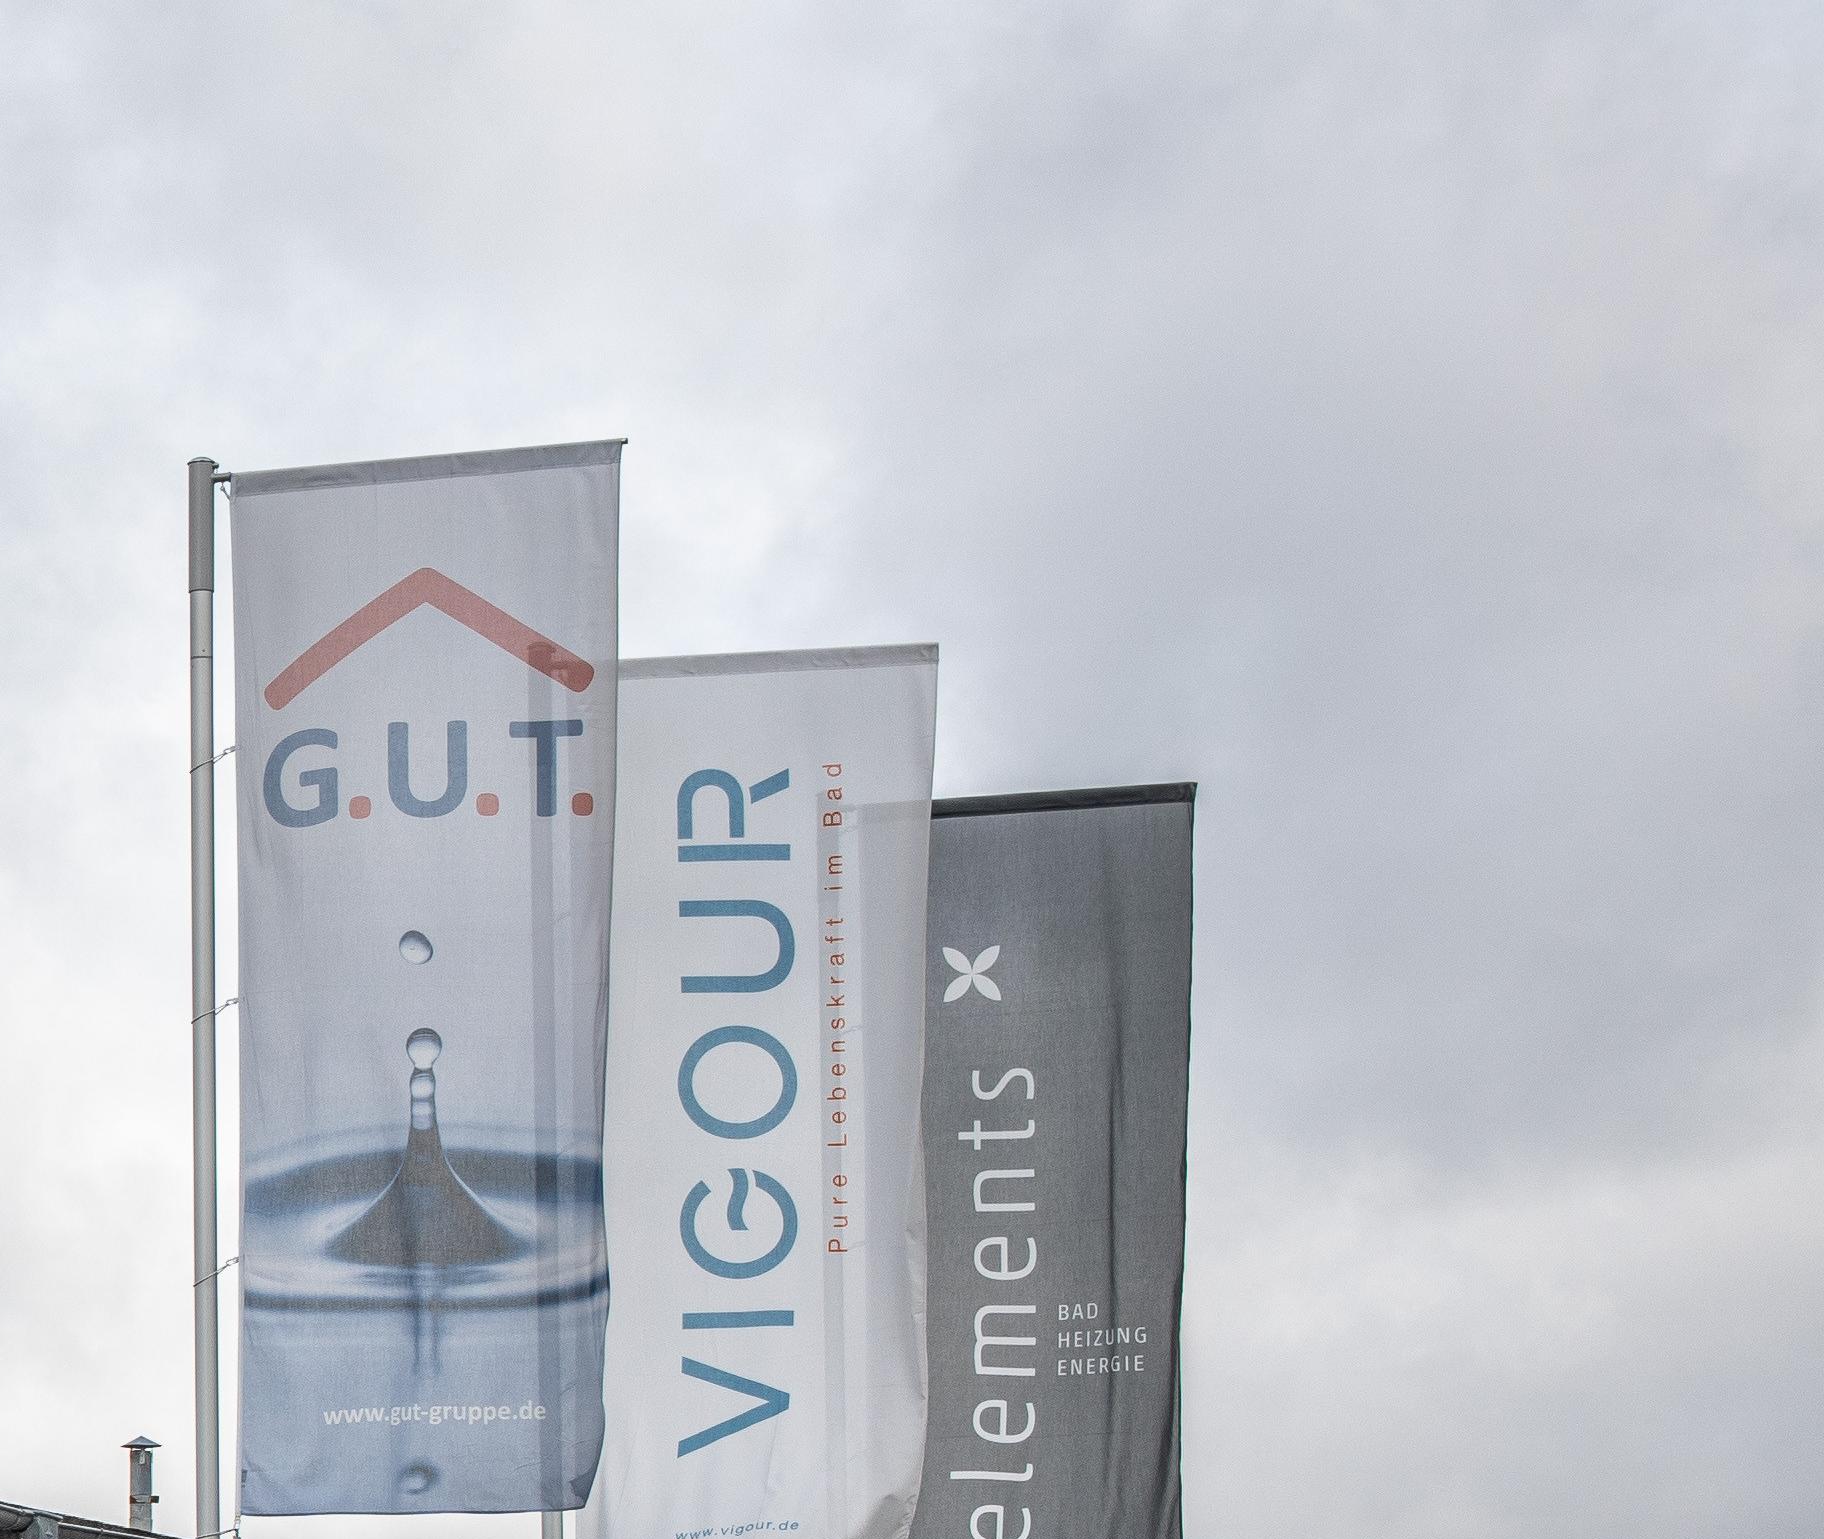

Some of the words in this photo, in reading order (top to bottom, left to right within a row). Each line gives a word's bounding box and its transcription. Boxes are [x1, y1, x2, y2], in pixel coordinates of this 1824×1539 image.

[262, 719, 595, 828] G.U.T.
[822, 762, 843, 828] Bad
[824, 854, 844, 890] im
[825, 917, 848, 1147] Lebenskraft
[676, 766, 798, 1460] VIGOUR
[827, 1173, 848, 1254] Pure
[1058, 1302, 1098, 1320] BAD
[1058, 1326, 1147, 1348] HEIZUNG
[1057, 1355, 1145, 1376] ENERGIE
[323, 1400, 547, 1425] www.gut-gruppe.de
